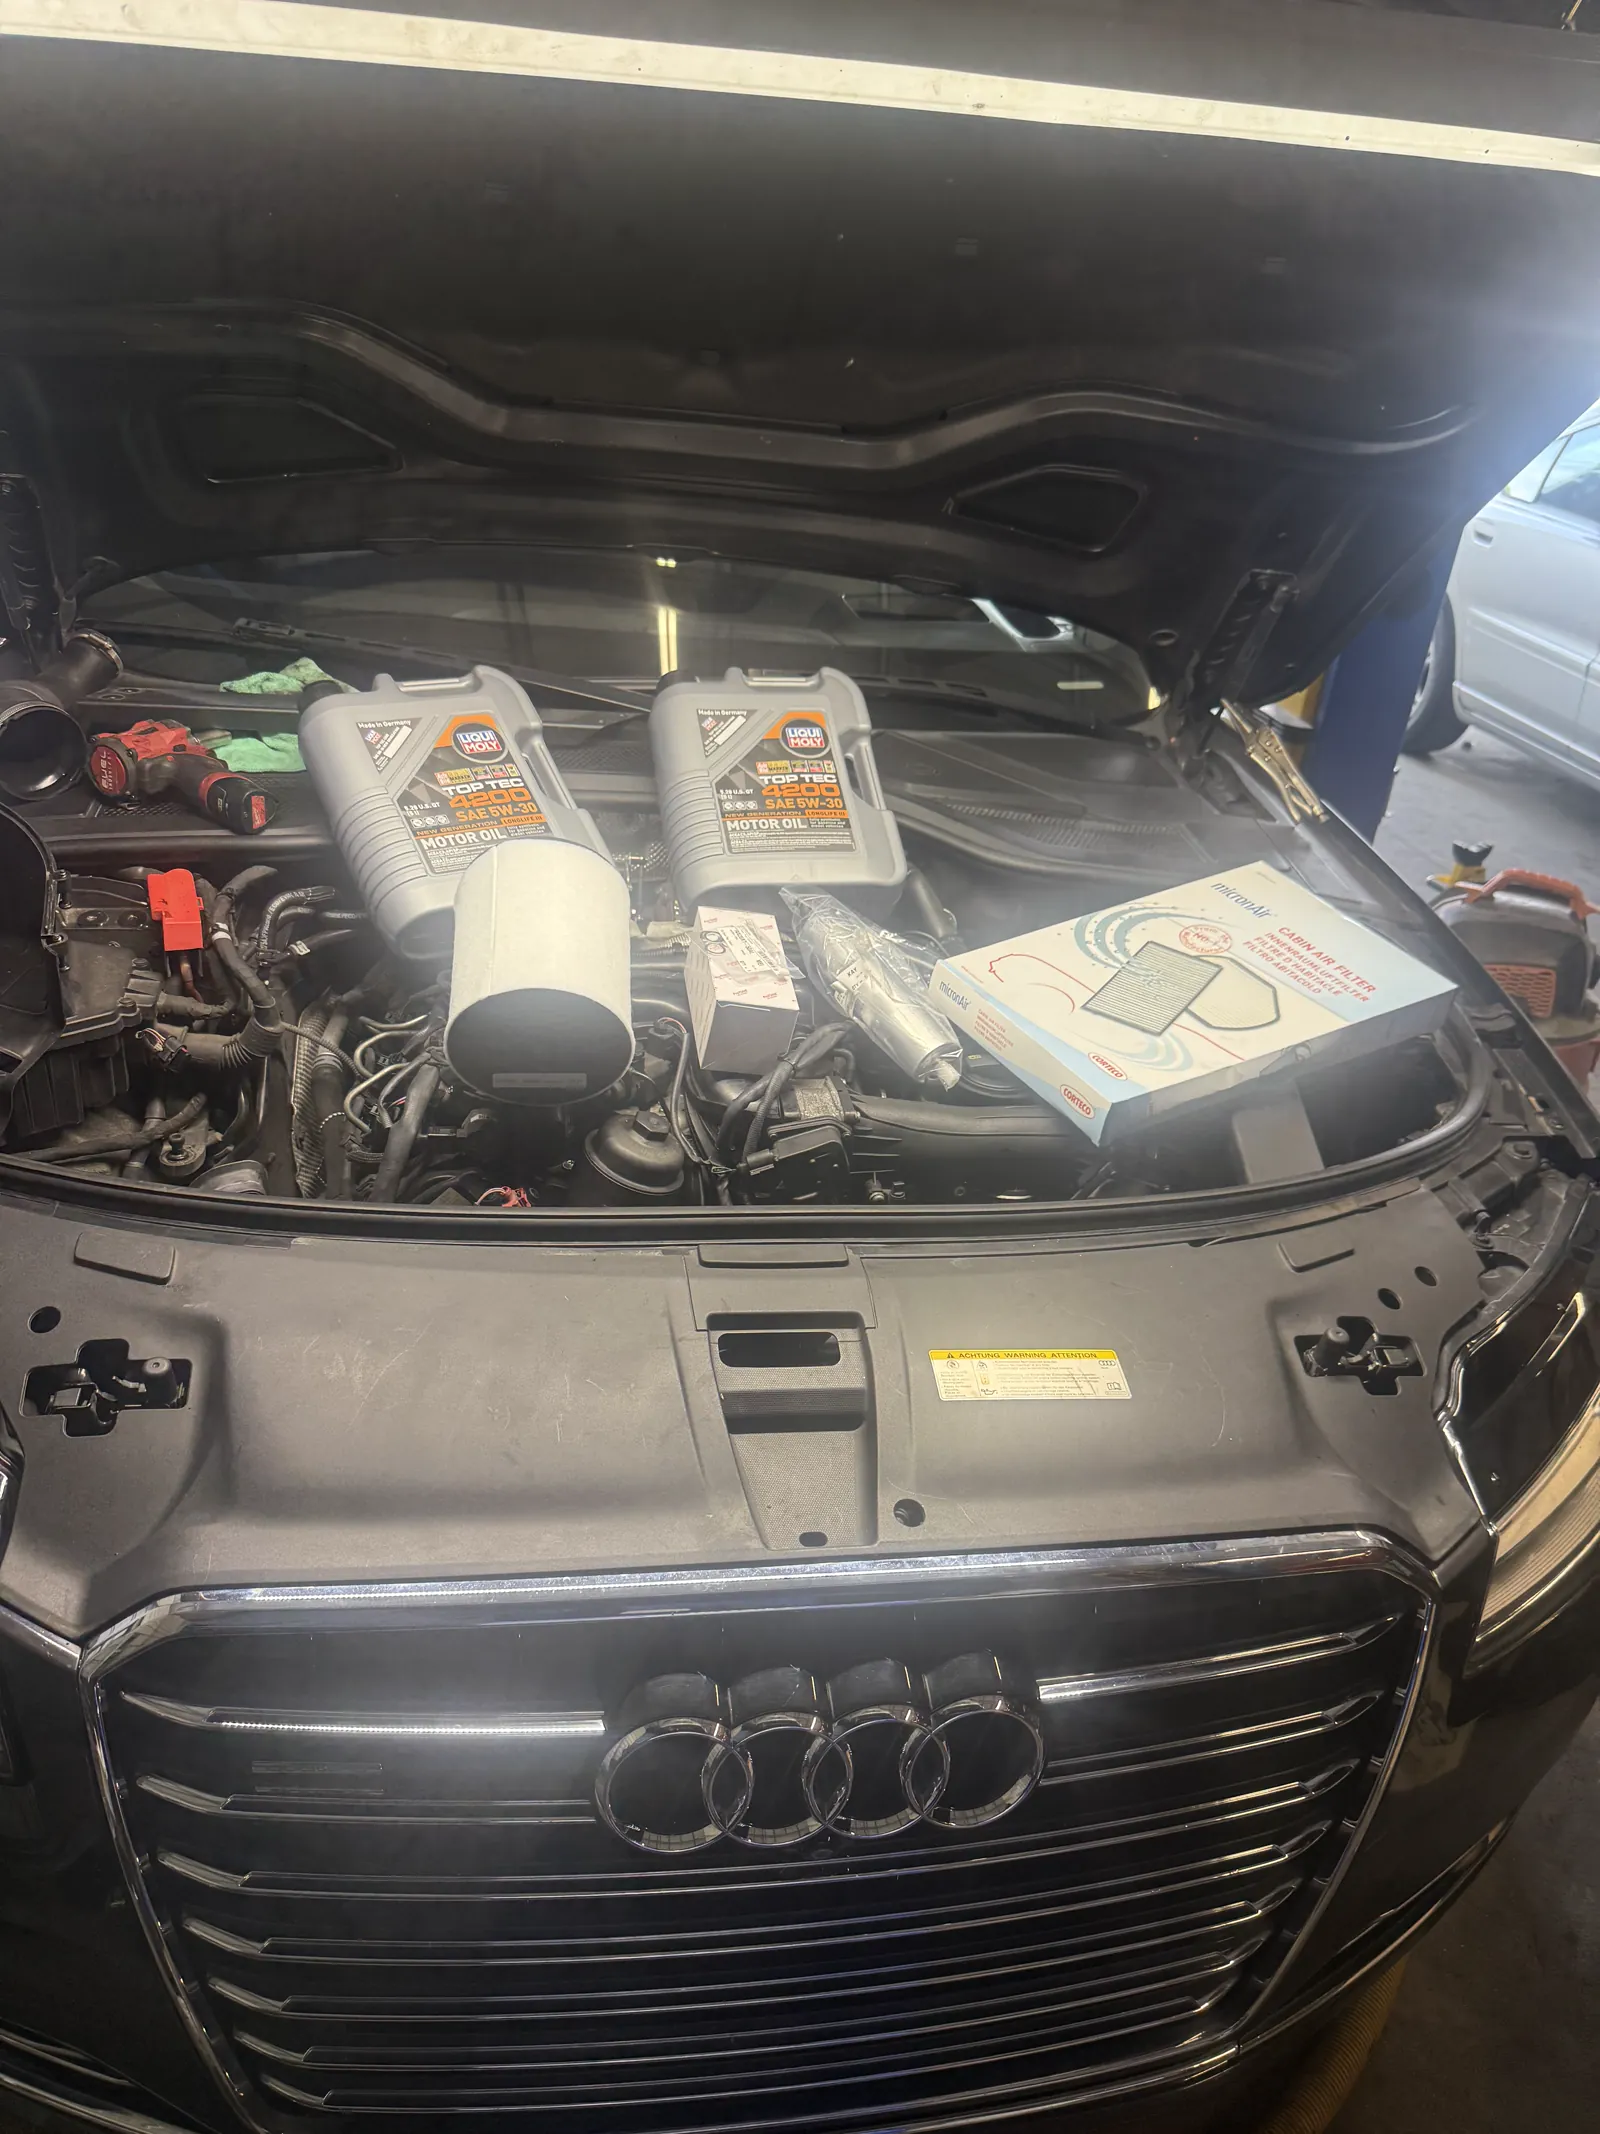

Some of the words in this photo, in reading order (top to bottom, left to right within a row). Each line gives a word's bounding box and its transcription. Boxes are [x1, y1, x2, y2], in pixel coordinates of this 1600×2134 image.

[720, 709, 747, 717] Germany
[383, 719, 412, 727] Germany
[459, 730, 495, 743] LIQUI
[788, 728, 821, 738] LIQUI
[463, 741, 498, 753] MOLY
[789, 737, 822, 747] MOLY
[441, 782, 485, 797] TOP
[484, 777, 525, 789] TEC
[759, 775, 798, 785] TOP
[799, 773, 838, 783] TEC
[449, 787, 532, 809] 4200
[761, 783, 841, 798] 4200
[765, 798, 796, 810] SAE
[797, 797, 844, 809] 5W-30
[455, 807, 490, 823] SAE
[488, 801, 538, 818] 5W-30
[747, 810, 802, 818] GENERATION
[416, 828, 438, 837] NEW
[439, 820, 498, 833] GENERATION
[503, 816, 535, 825] LONGLIFE
[726, 818, 781, 831] MOTOR
[781, 818, 808, 829] OIL
[419, 830, 480, 850] MOTOR
[480, 827, 508, 841] OIL
[1210, 881, 1273, 919] micronAir
[1252, 935, 1284, 958] FILTRE
[1242, 940, 1275, 964] FILTRO
[1271, 962, 1322, 995] ABITACOLO
[1264, 931, 1370, 1003] INNENRAUMLUFTFILTER
[1277, 926, 1317, 951] CABIN
[1313, 950, 1336, 966] AIR
[1333, 964, 1378, 994] FILTER
[938, 979, 971, 1012] micronAir
[1091, 1053, 1125, 1079] CORTECO
[1062, 1086, 1092, 1116] CORTECO
[958, 1352, 1001, 1360] ACHTUNG
[1003, 1352, 1047, 1360] WARNING
[1050, 1352, 1098, 1360] ATTENTION
